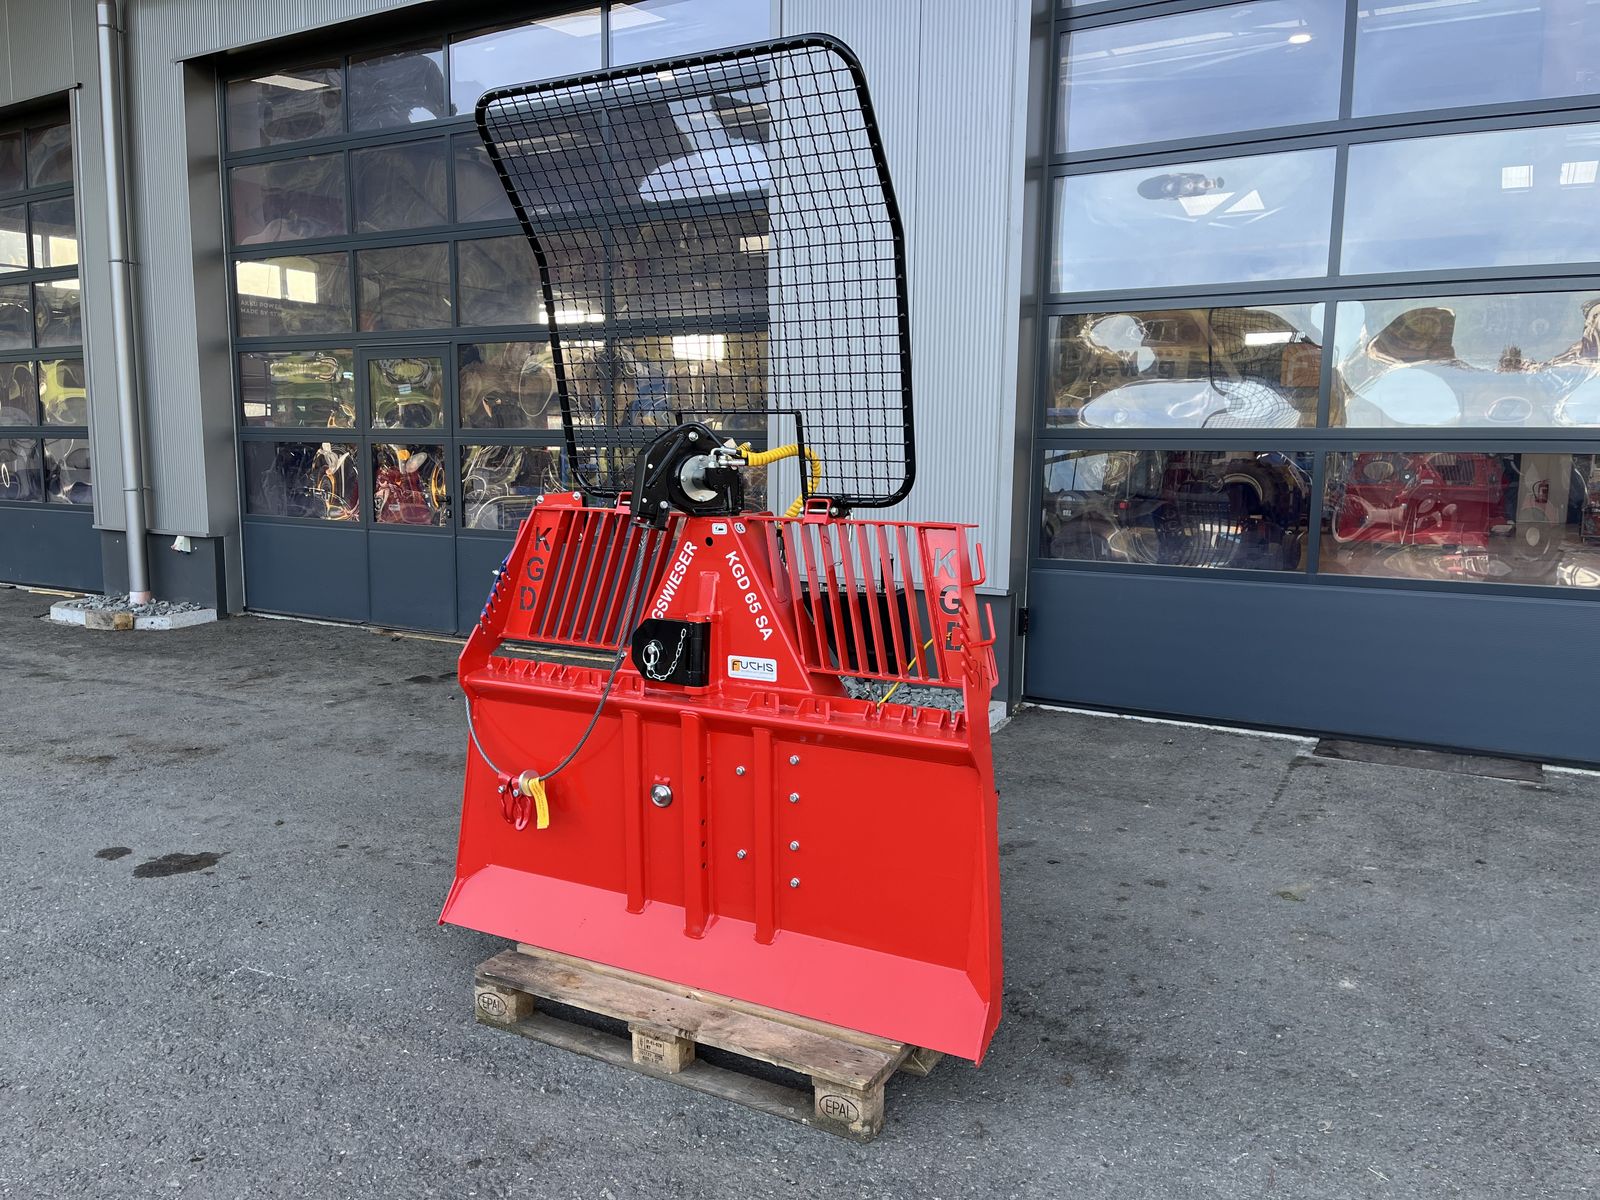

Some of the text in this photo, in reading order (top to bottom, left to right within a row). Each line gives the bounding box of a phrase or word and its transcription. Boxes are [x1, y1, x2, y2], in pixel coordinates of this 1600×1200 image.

[519, 527, 552, 611] KGD
[651, 541, 698, 619] GSWIESER
[725, 550, 773, 641] KGD 65 SA
[732, 660, 774, 673] FUCHS
